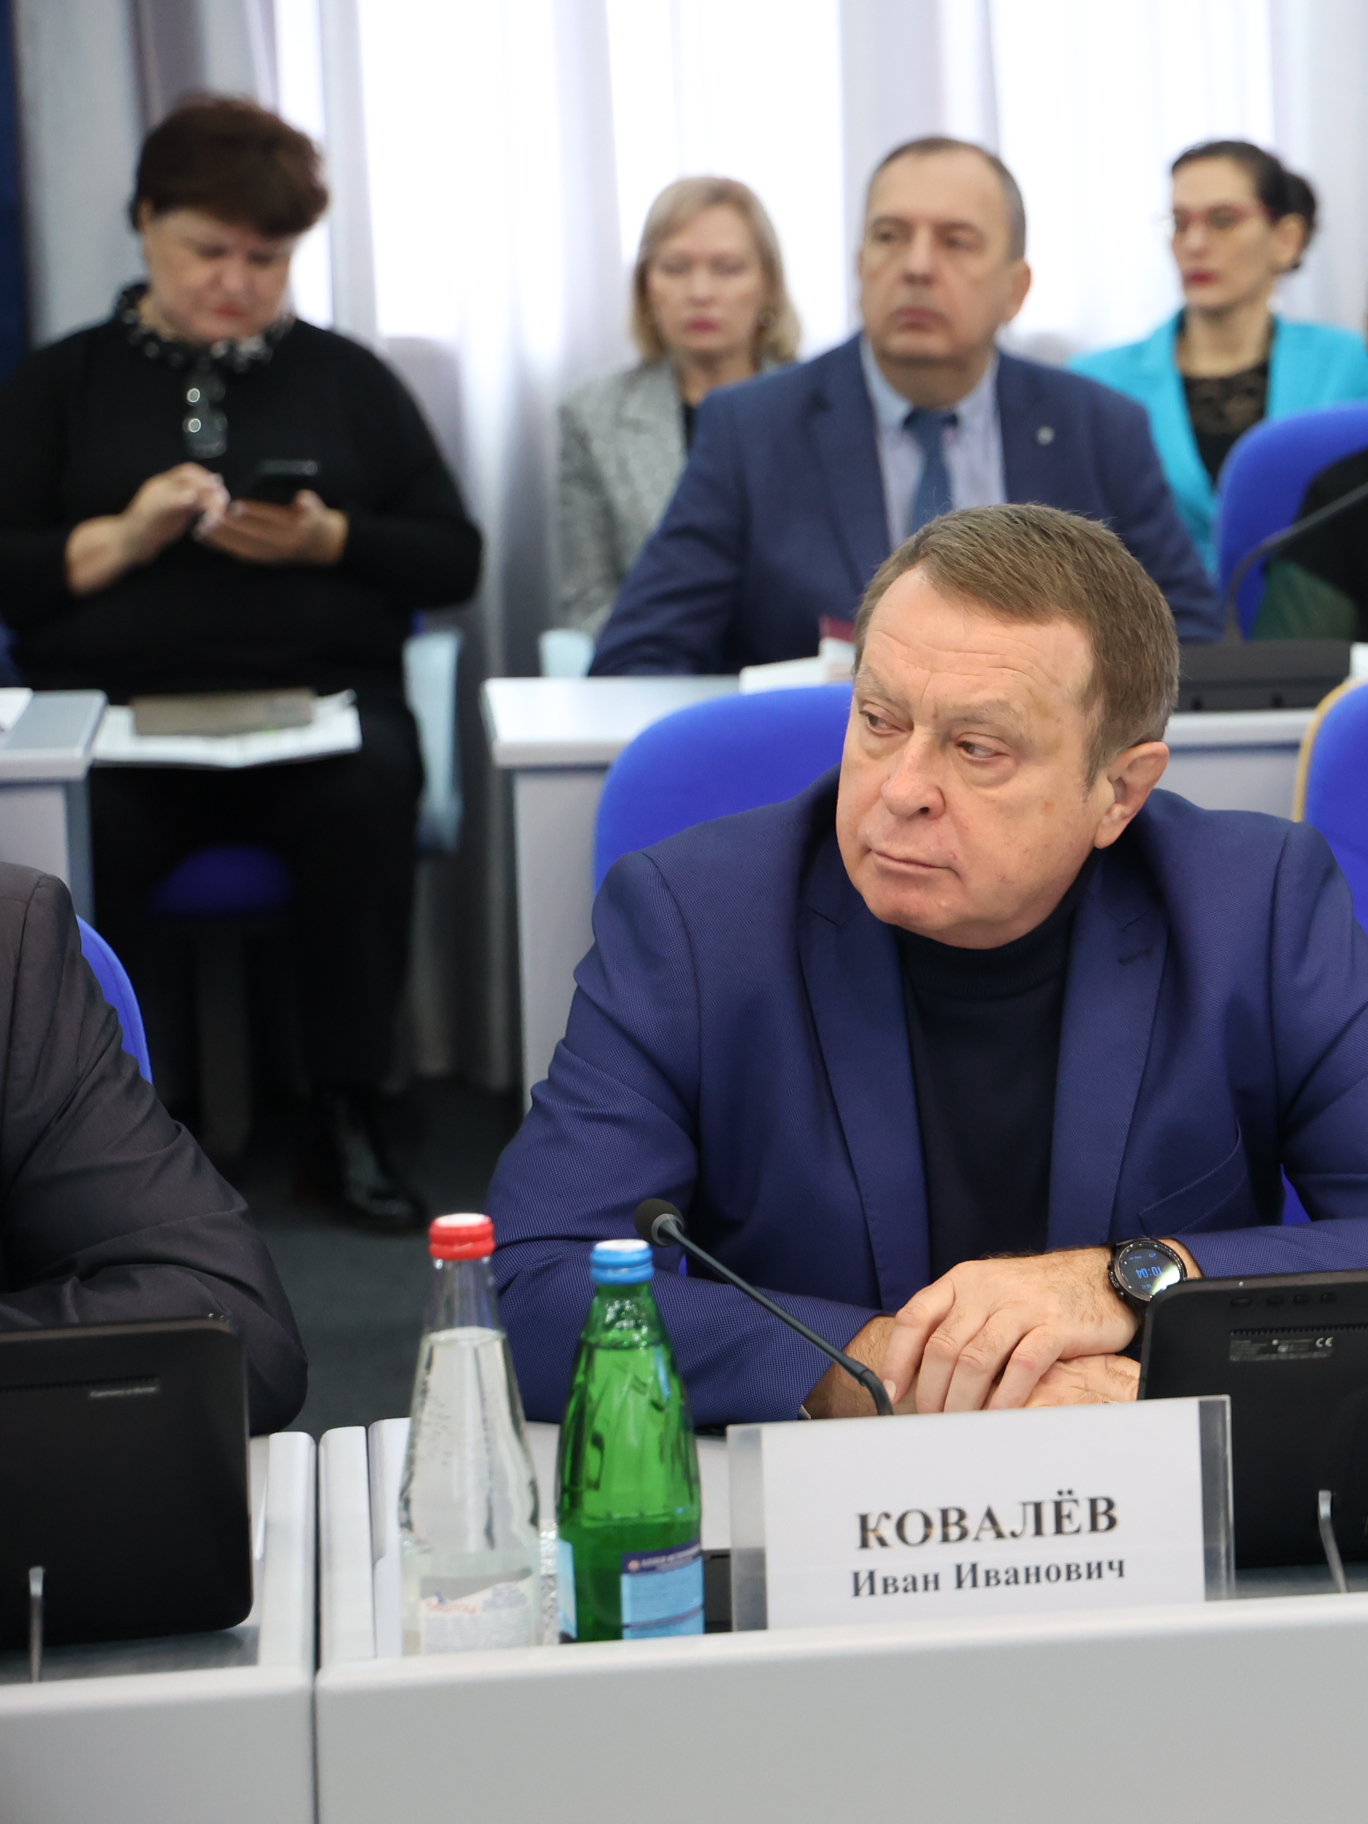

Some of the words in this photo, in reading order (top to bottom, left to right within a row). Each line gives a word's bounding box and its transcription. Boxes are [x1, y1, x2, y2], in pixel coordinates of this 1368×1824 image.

[1135, 1265, 1163, 1280] 10:04
[1315, 1336, 1334, 1348] CE
[856, 1488, 1119, 1551] КОВАЛЁВ
[851, 1568, 941, 1598] Иван
[954, 1558, 1126, 1590] Иванович
